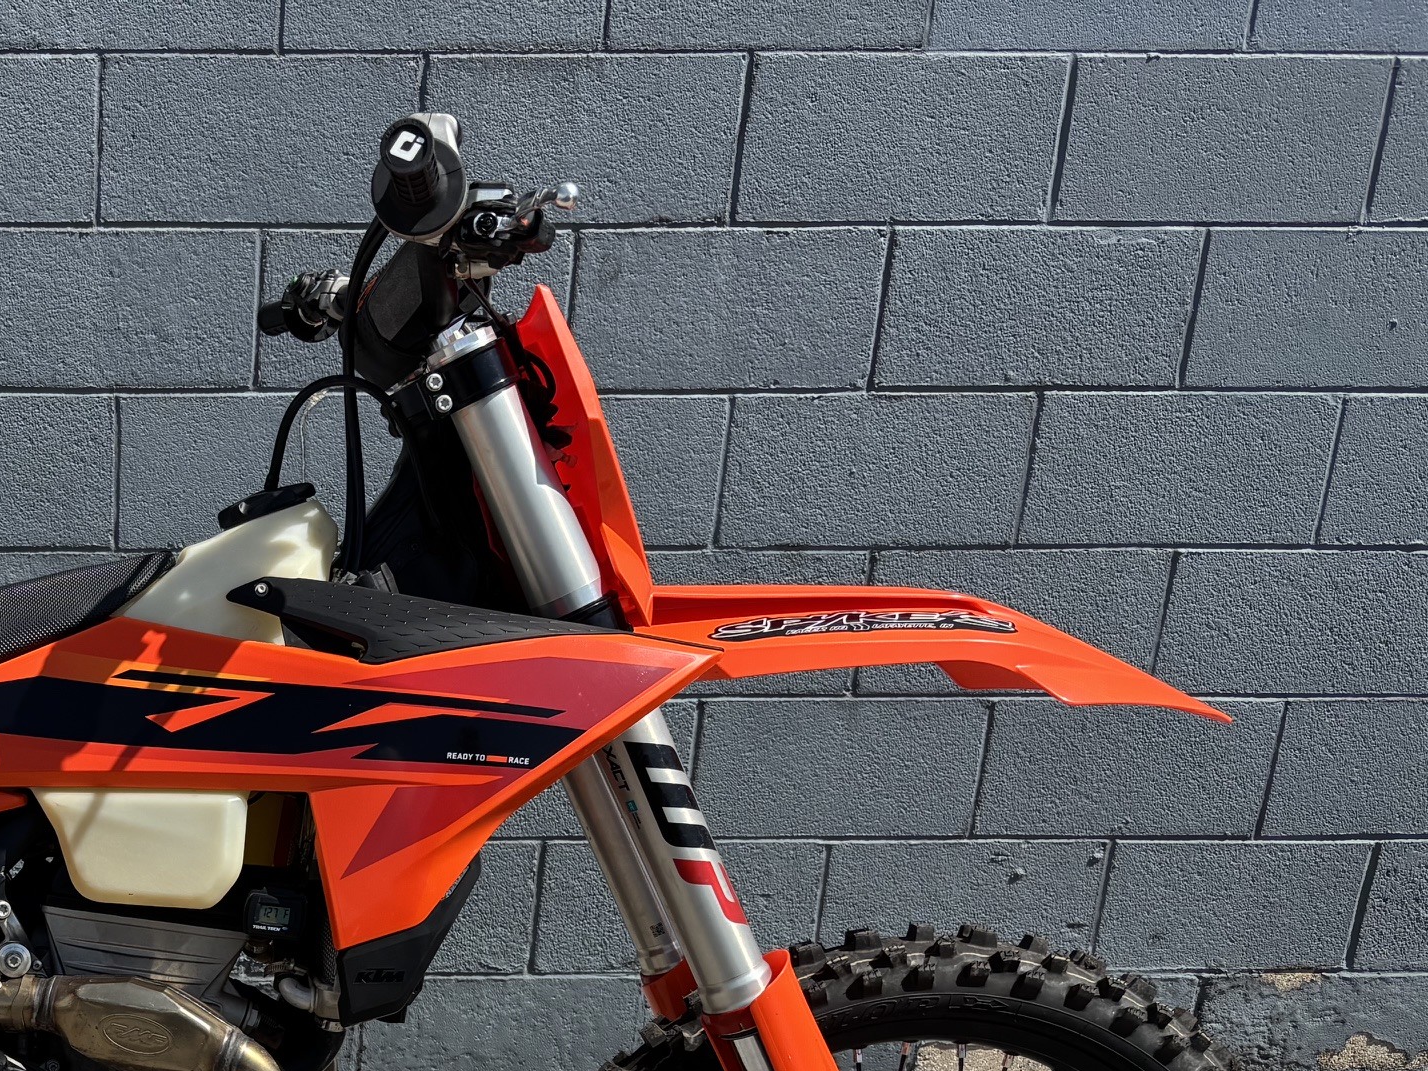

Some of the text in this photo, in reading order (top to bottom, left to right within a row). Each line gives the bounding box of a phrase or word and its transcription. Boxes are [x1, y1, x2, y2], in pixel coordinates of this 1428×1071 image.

[446, 751, 530, 765] READY TO RACE
[602, 745, 630, 792] XACT
[263, 907, 289, 919] 127 F
[353, 967, 406, 984] KTM
